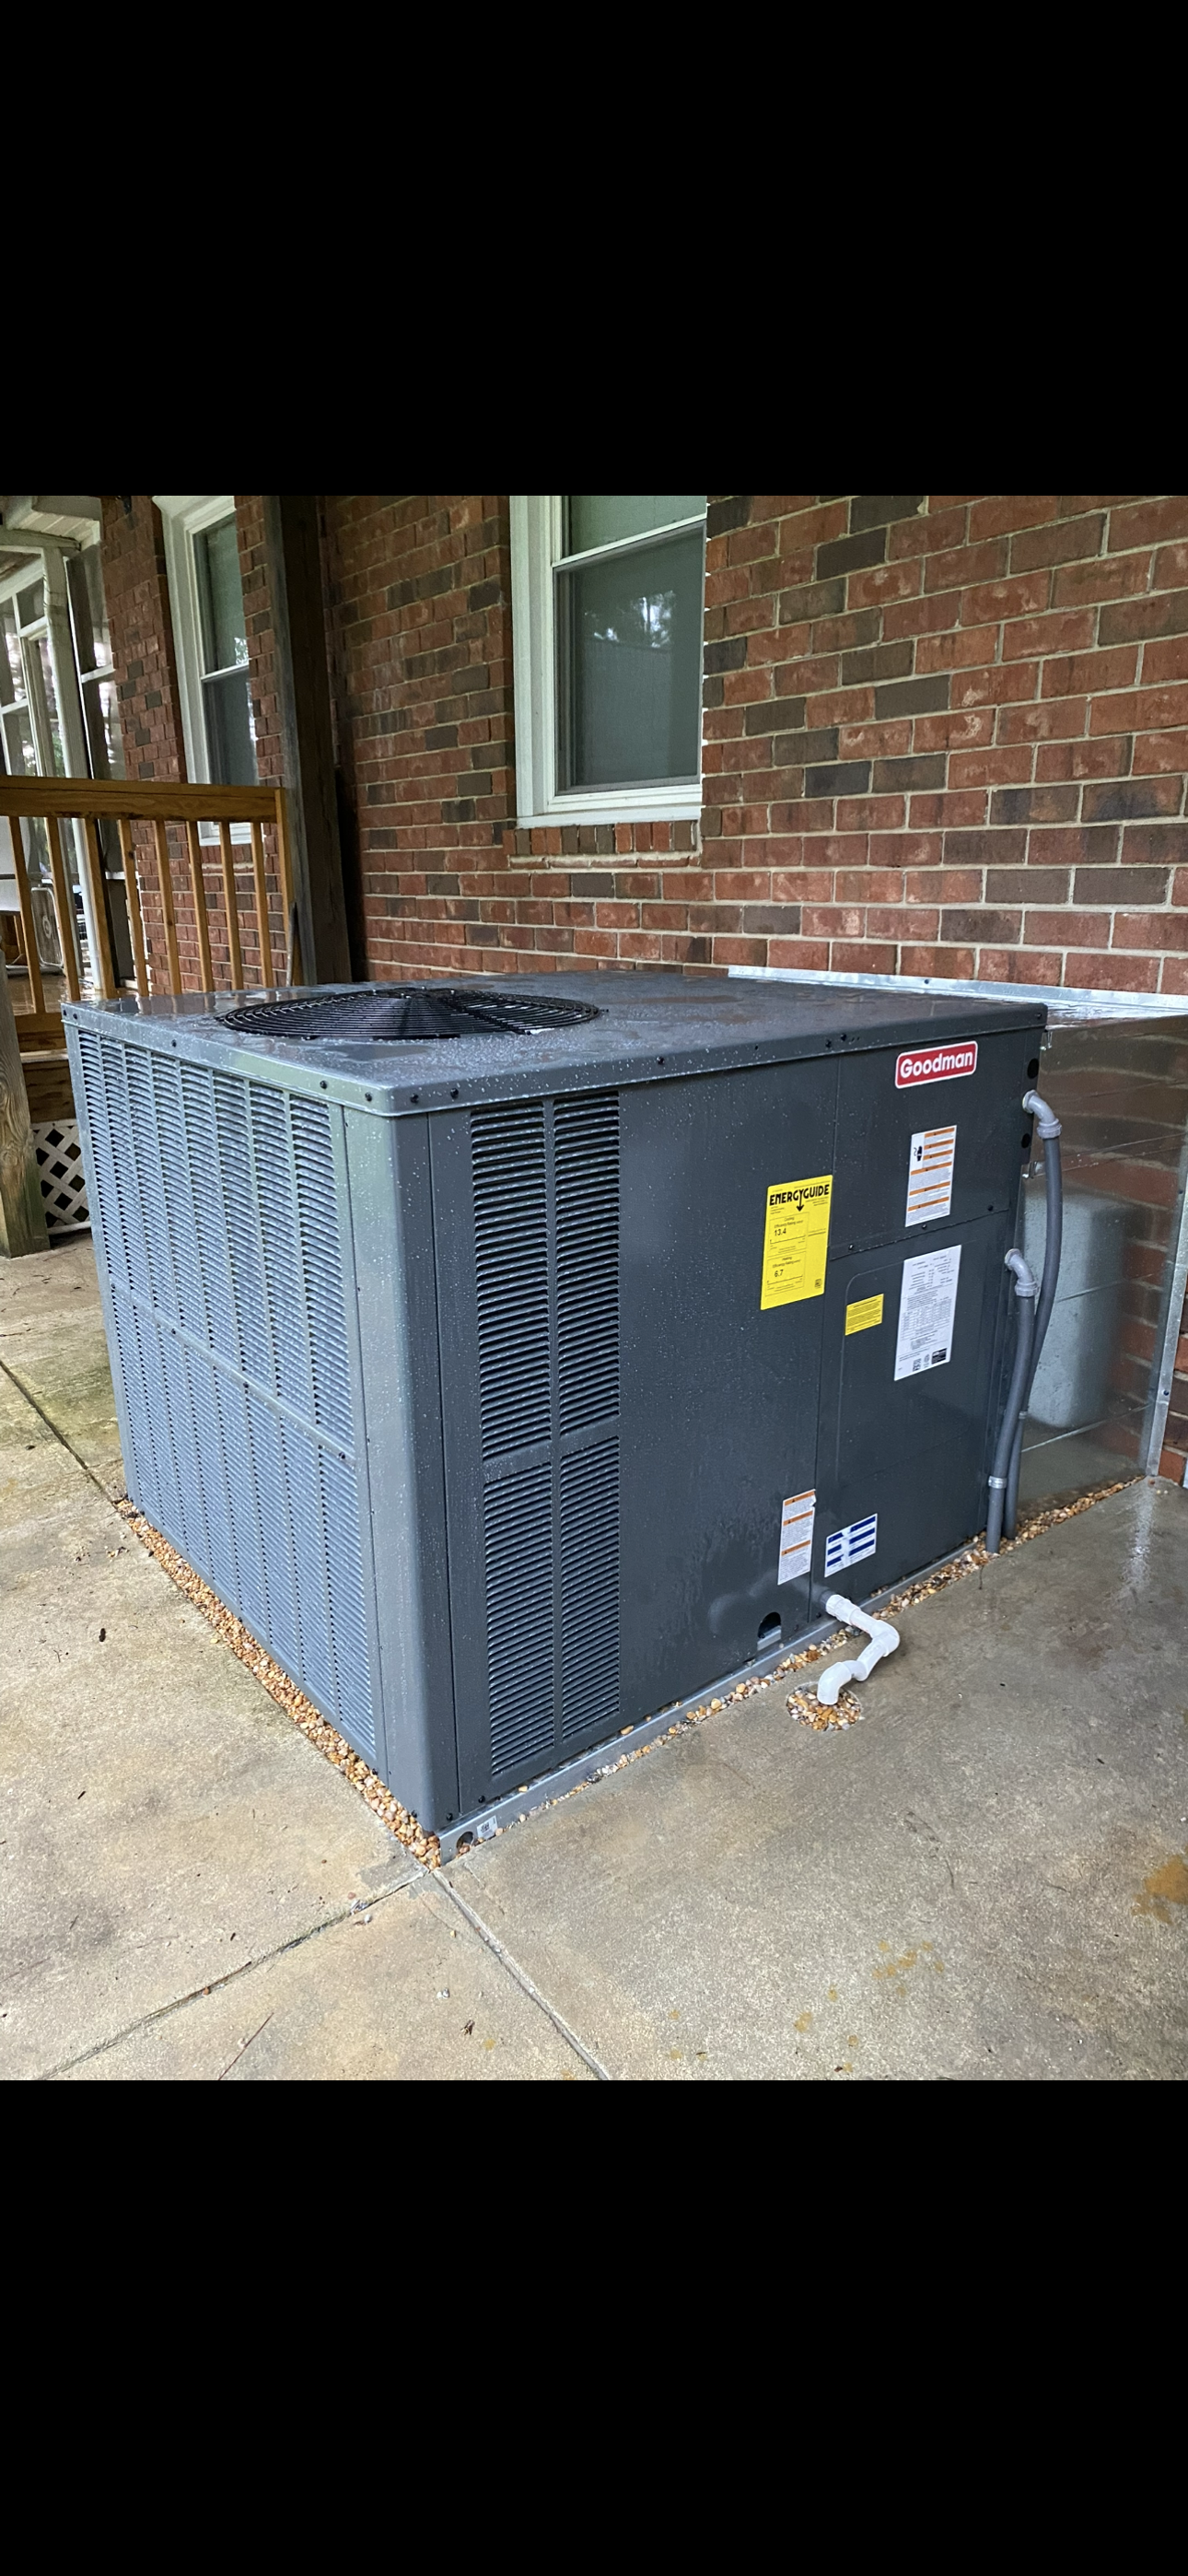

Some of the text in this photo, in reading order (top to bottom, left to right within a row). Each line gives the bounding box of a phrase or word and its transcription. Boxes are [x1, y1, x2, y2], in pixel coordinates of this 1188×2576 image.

[900, 1051, 973, 1078] Goodman
[769, 1184, 830, 1207] ENERGYGUIDE
[774, 1228, 786, 1236] 13.4
[774, 1269, 784, 1278] 6.7
